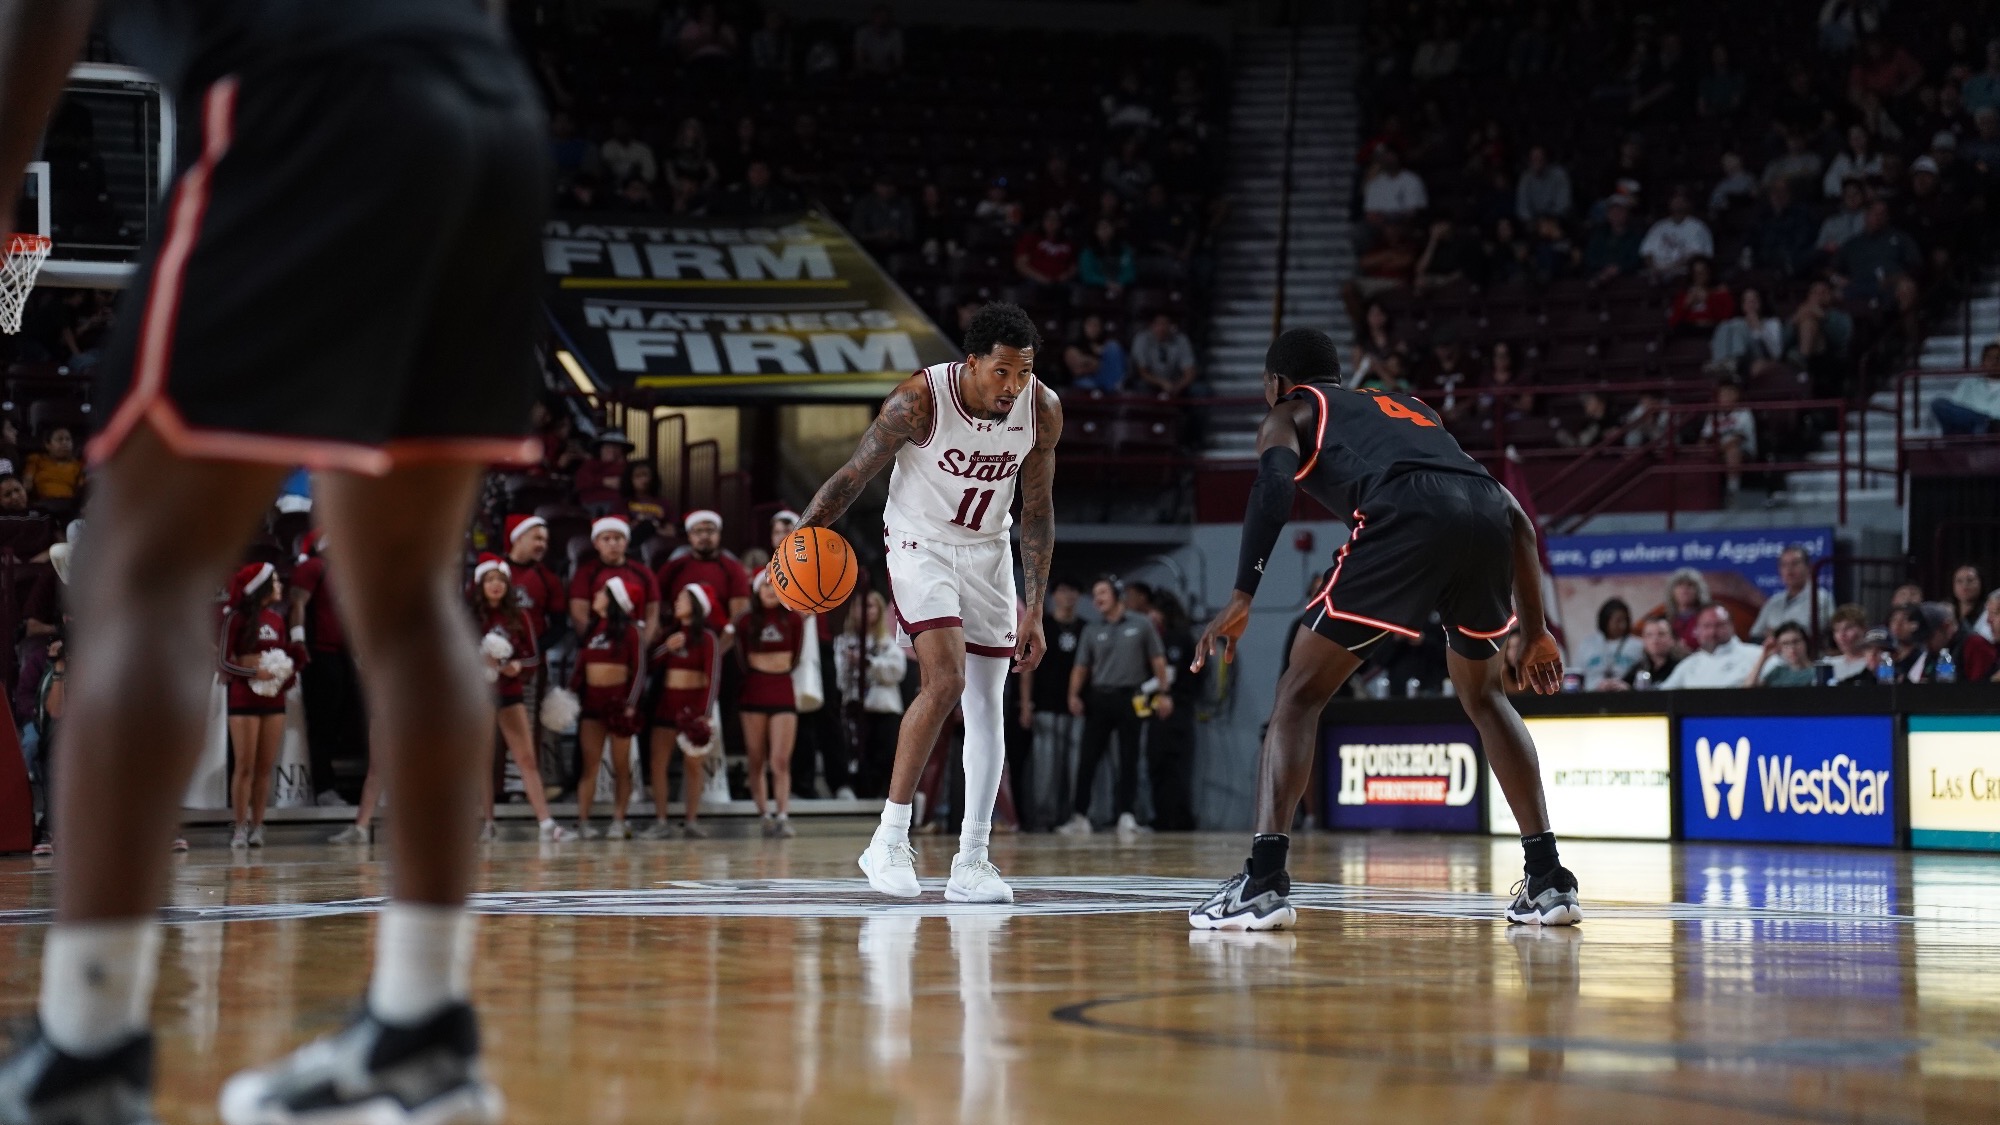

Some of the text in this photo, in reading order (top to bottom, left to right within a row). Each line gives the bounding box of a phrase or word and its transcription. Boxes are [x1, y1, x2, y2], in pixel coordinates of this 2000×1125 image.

[542, 238, 836, 281] FIRM
[583, 306, 898, 331] MATTRESS
[607, 328, 922, 374] FIRM
[1372, 395, 1438, 427] 4
[938, 448, 1019, 482] State
[950, 487, 996, 531] 11
[1590, 548, 1617, 569] go
[1619, 542, 1679, 563] where
[1682, 540, 1715, 561] the
[1338, 743, 1478, 806] HOUSEHOLD
[1757, 753, 1890, 816] WestStar
